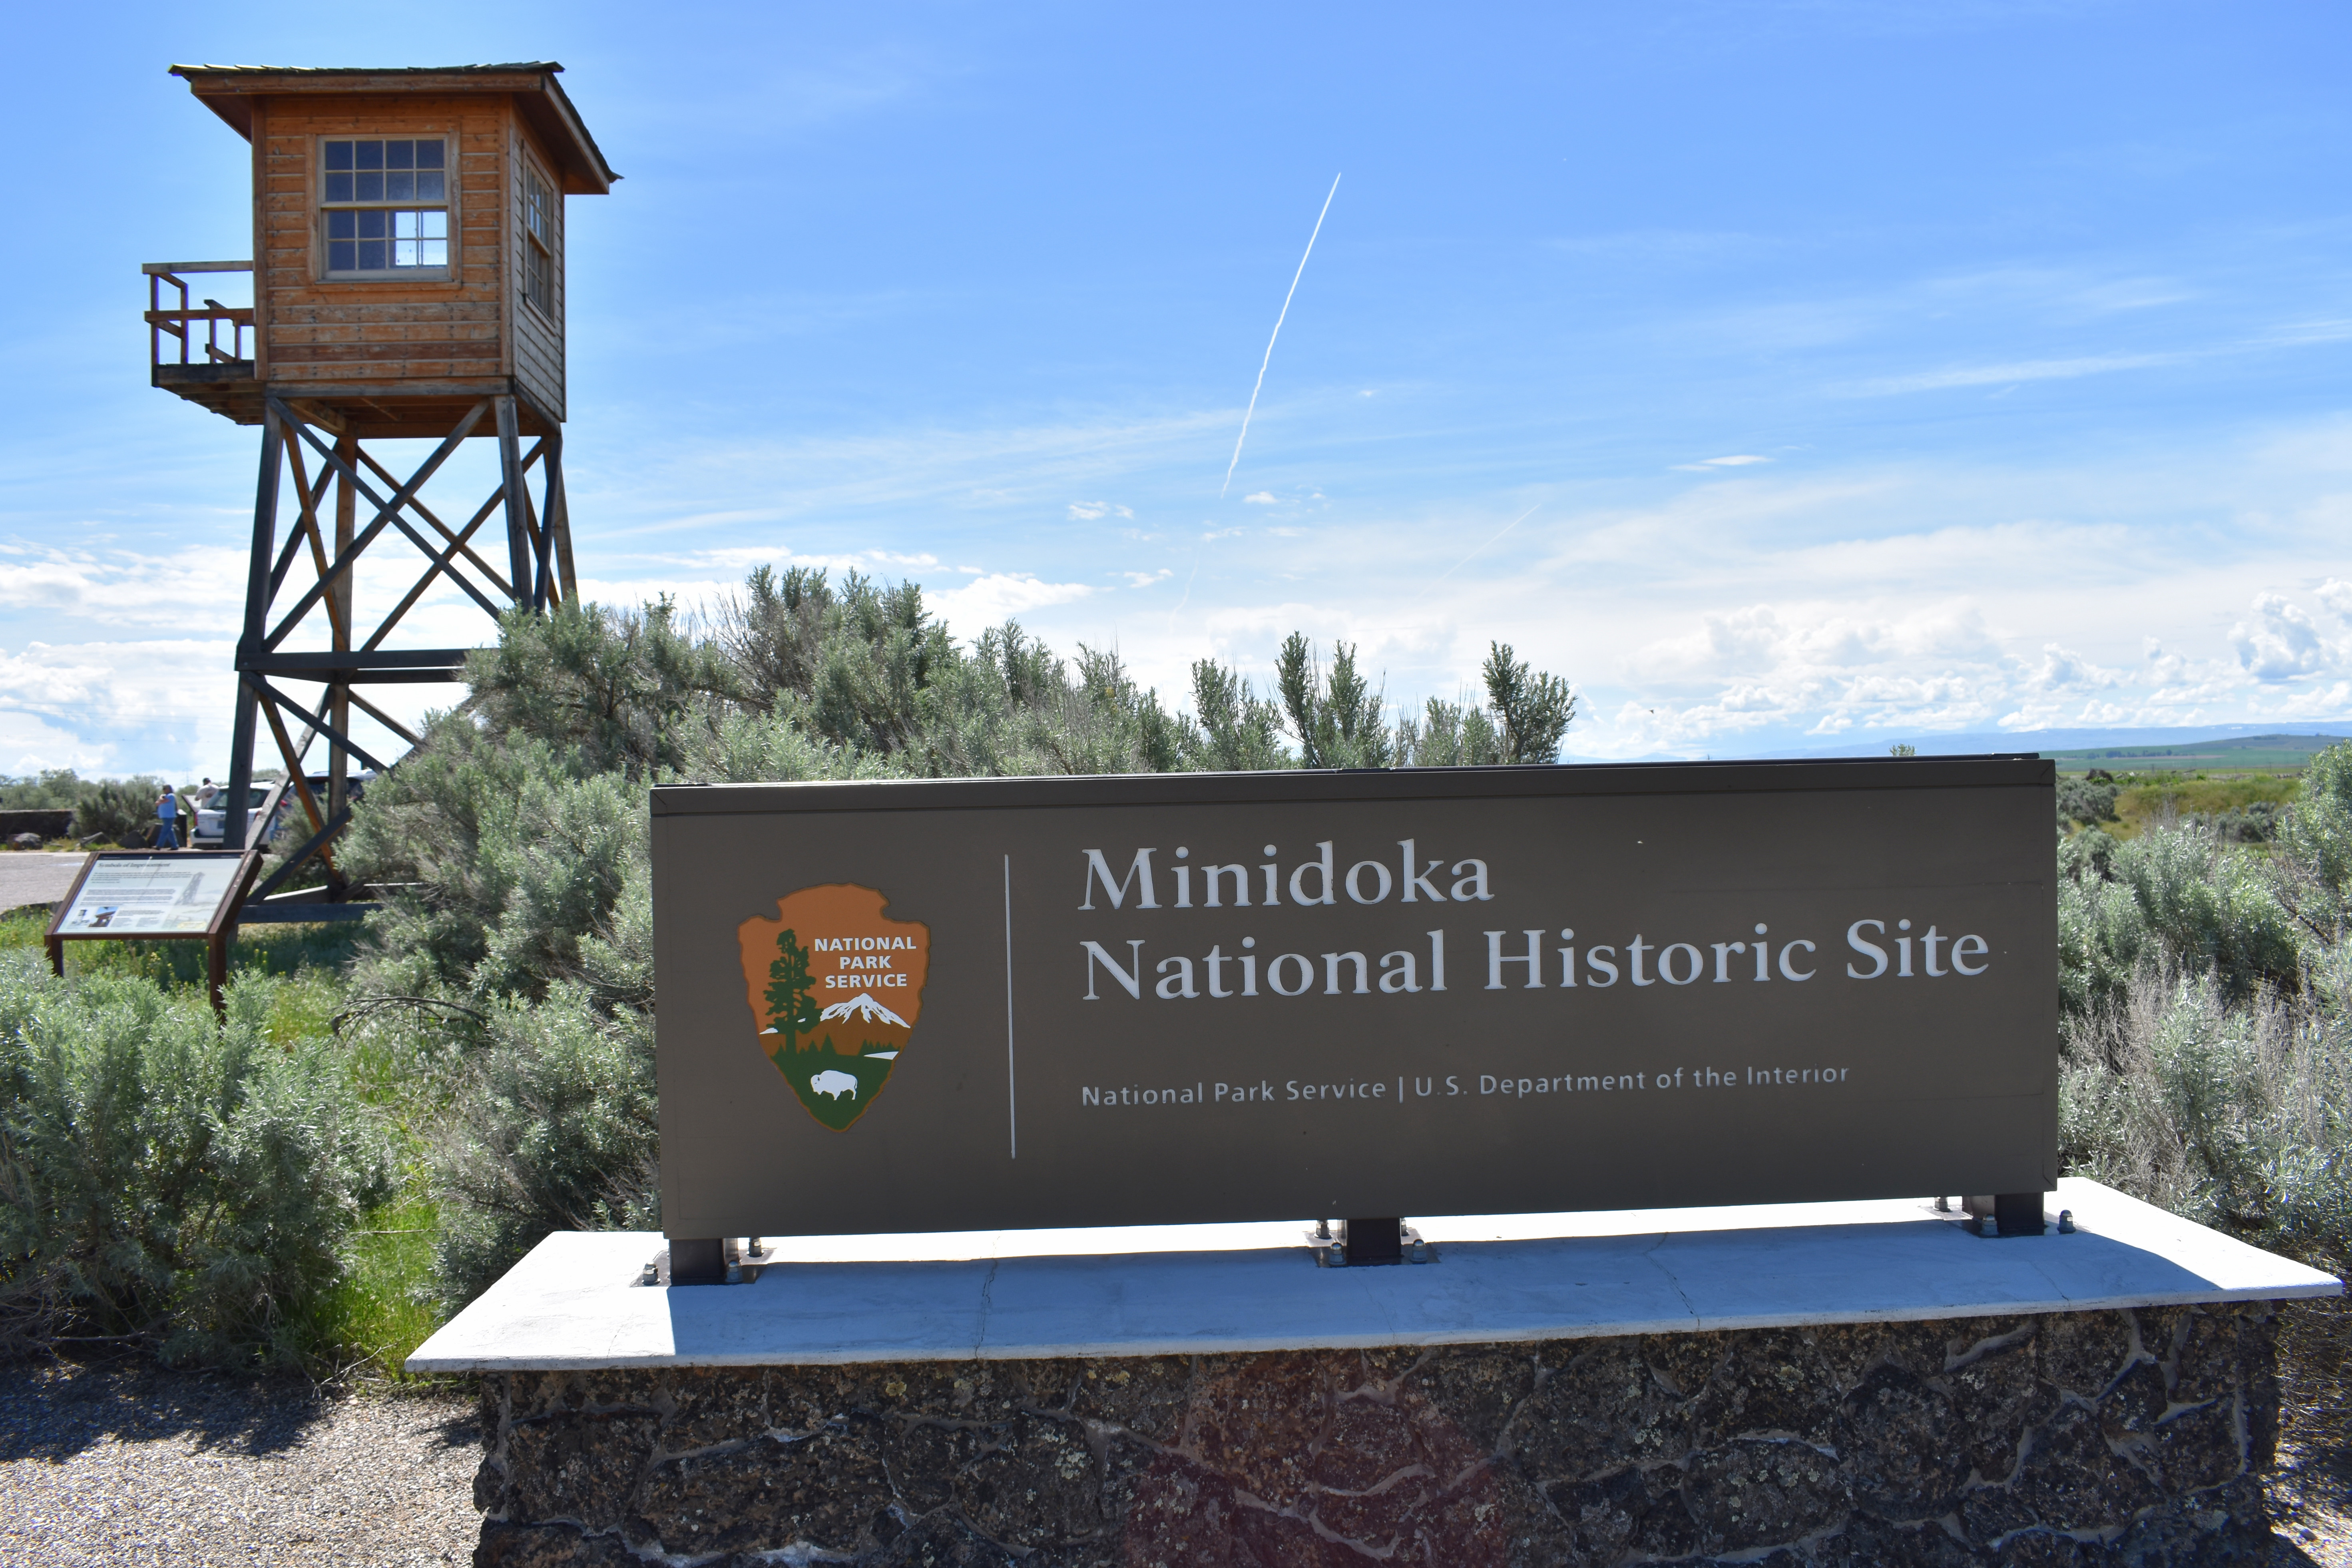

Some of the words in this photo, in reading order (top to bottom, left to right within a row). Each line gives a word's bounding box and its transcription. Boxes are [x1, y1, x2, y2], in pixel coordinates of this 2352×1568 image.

[1078, 838, 1495, 910] Minidoka
[814, 936, 917, 952] NATIONAL
[840, 955, 892, 970] PARK
[1079, 929, 1447, 1000] National
[1483, 923, 1816, 989] Historic
[1847, 919, 1989, 979] Site
[825, 973, 908, 989] SERVICE
[1082, 1082, 1203, 1106] National
[1215, 1080, 1275, 1102] Park
[1286, 1078, 1386, 1100] Service
[1416, 1076, 1468, 1096] U.S.
[1480, 1072, 1645, 1098] Department
[1656, 1067, 1684, 1088] of
[1693, 1066, 1737, 1087] the
[1748, 1064, 1849, 1085] Interior
